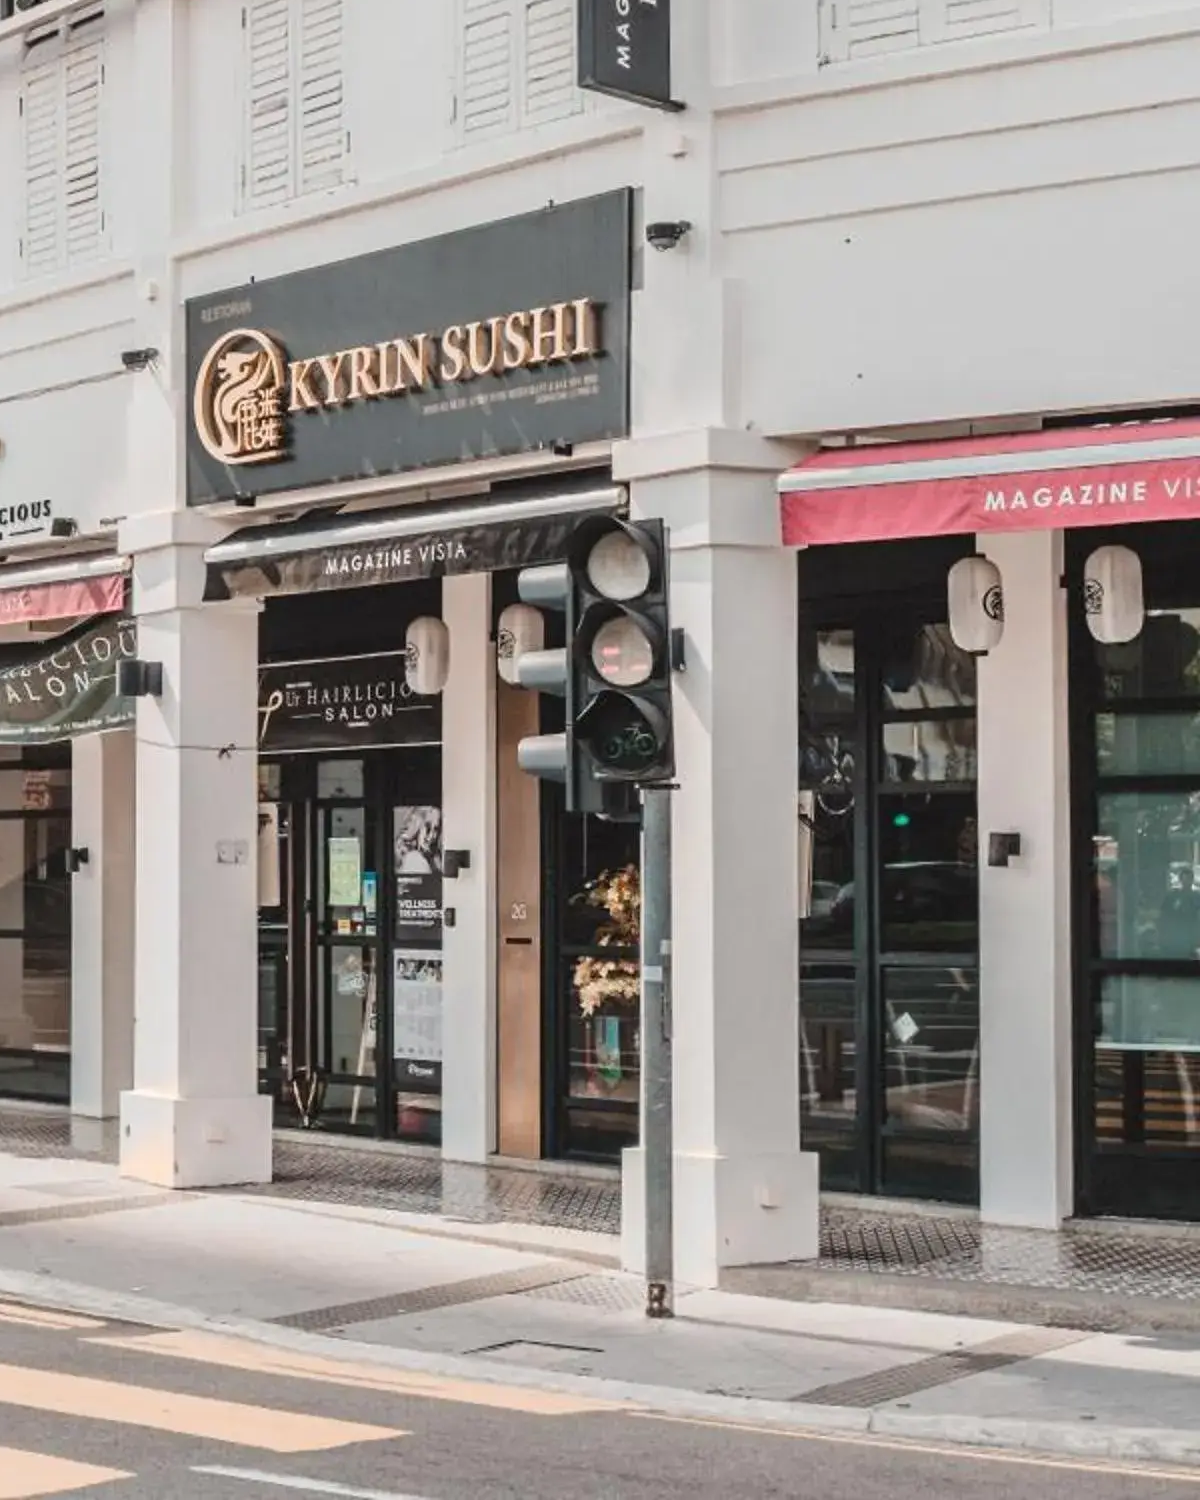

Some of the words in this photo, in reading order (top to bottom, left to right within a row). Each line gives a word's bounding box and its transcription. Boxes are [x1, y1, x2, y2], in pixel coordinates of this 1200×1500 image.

[288, 333, 430, 411] KYRIN
[441, 298, 594, 381] SUSHI
[984, 481, 1147, 511] MAGAZINE
[325, 548, 412, 575] MAGAZINE
[419, 541, 468, 563] VISTA
[307, 681, 413, 705] HAIRLICIO
[325, 703, 394, 722] SALON
